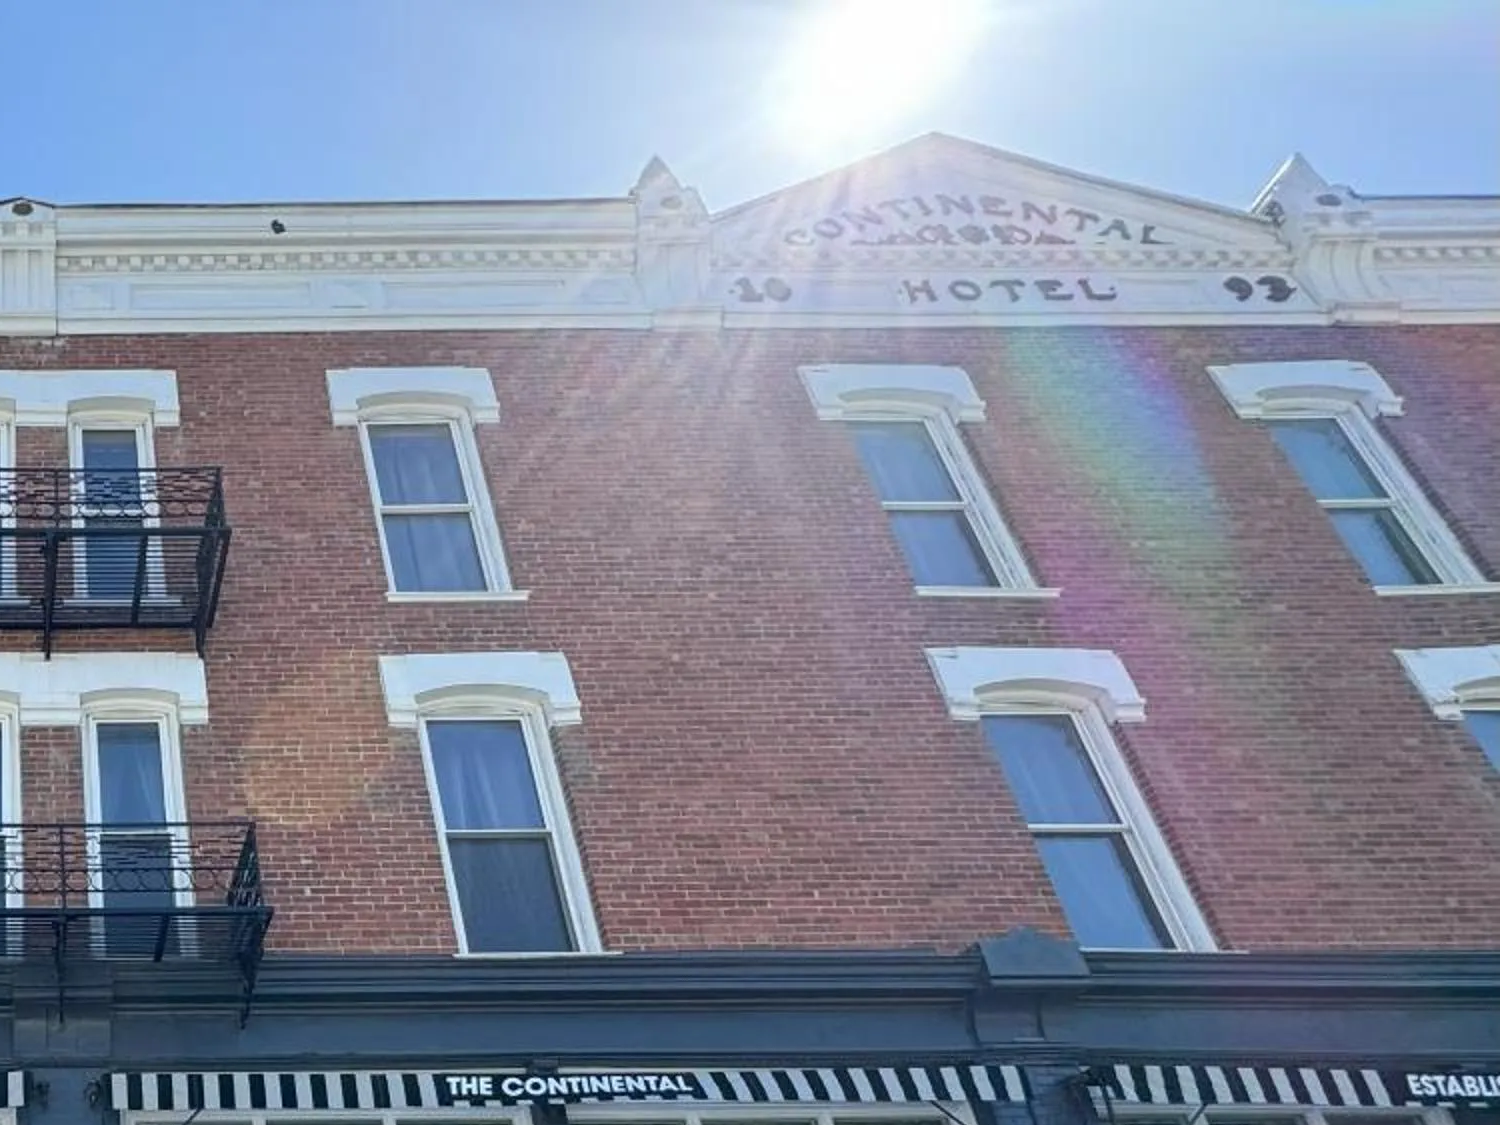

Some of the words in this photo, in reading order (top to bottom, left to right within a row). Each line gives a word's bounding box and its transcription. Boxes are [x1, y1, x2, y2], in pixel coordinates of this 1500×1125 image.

[784, 194, 1174, 246] CONTINENTAL
[902, 278, 1118, 304] HOTEL
[446, 1076, 493, 1096] THE
[501, 1075, 694, 1097] CONTINENTAL
